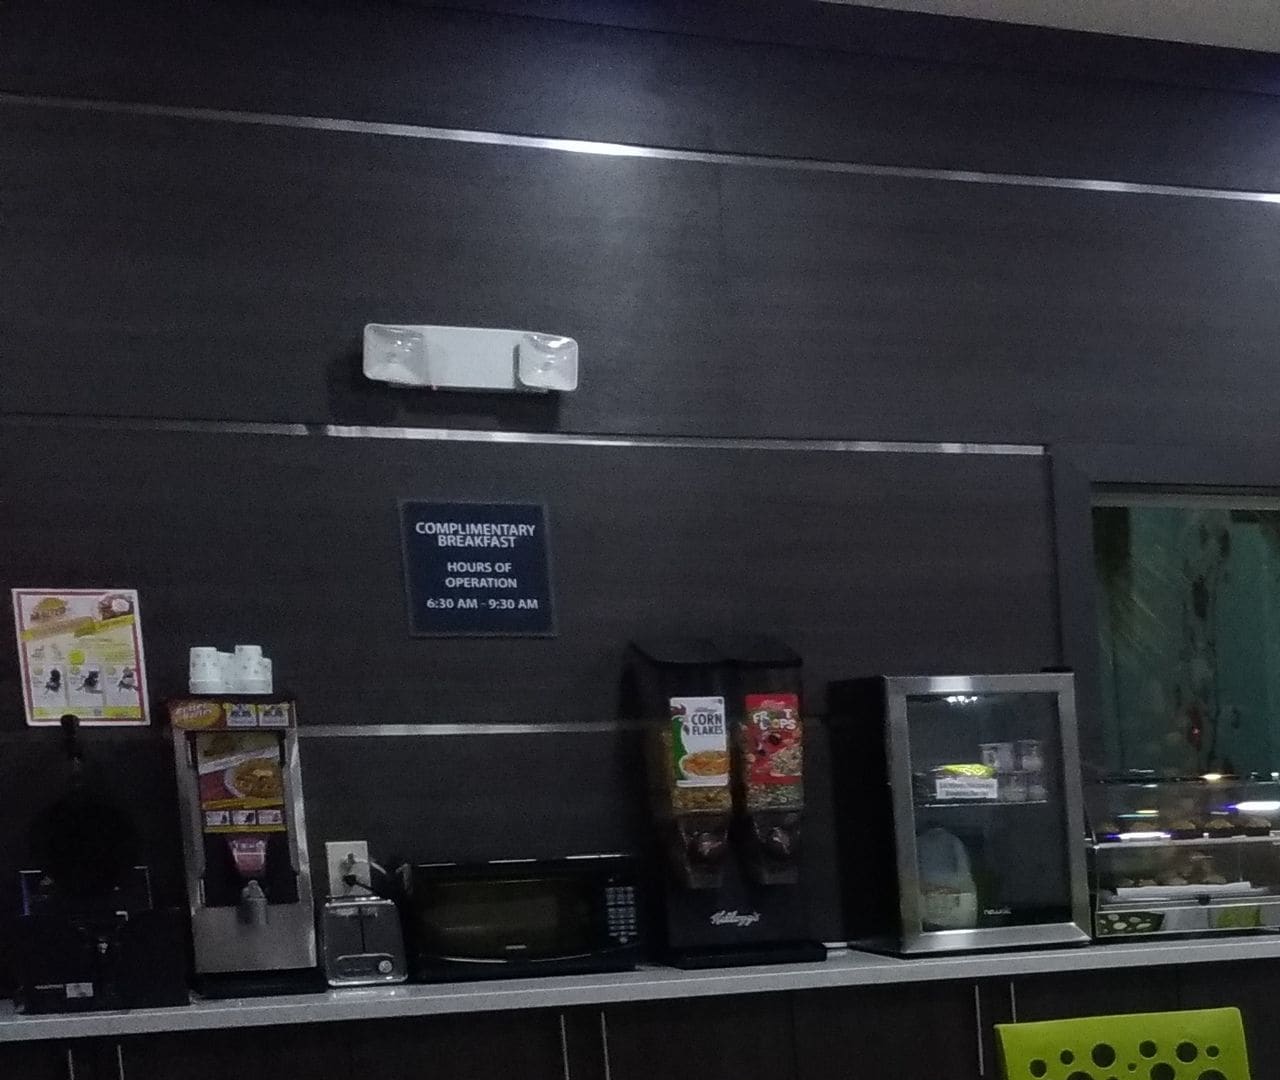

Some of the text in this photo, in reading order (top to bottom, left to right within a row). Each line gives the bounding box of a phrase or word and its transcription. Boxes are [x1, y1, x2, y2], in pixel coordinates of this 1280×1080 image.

[415, 521, 536, 537] COMPLIMENTARY
[437, 534, 517, 549] BREAKFAST
[447, 561, 512, 573] HOURS OF
[444, 577, 518, 589] OPERATION
[426, 598, 455, 609] 6:30
[456, 598, 479, 609] AM
[488, 598, 515, 610] 9:30
[517, 598, 539, 610] AM
[690, 713, 722, 726] CORN
[752, 708, 793, 724] FRT
[691, 725, 723, 736] FLAKES
[759, 718, 797, 731] LOPS
